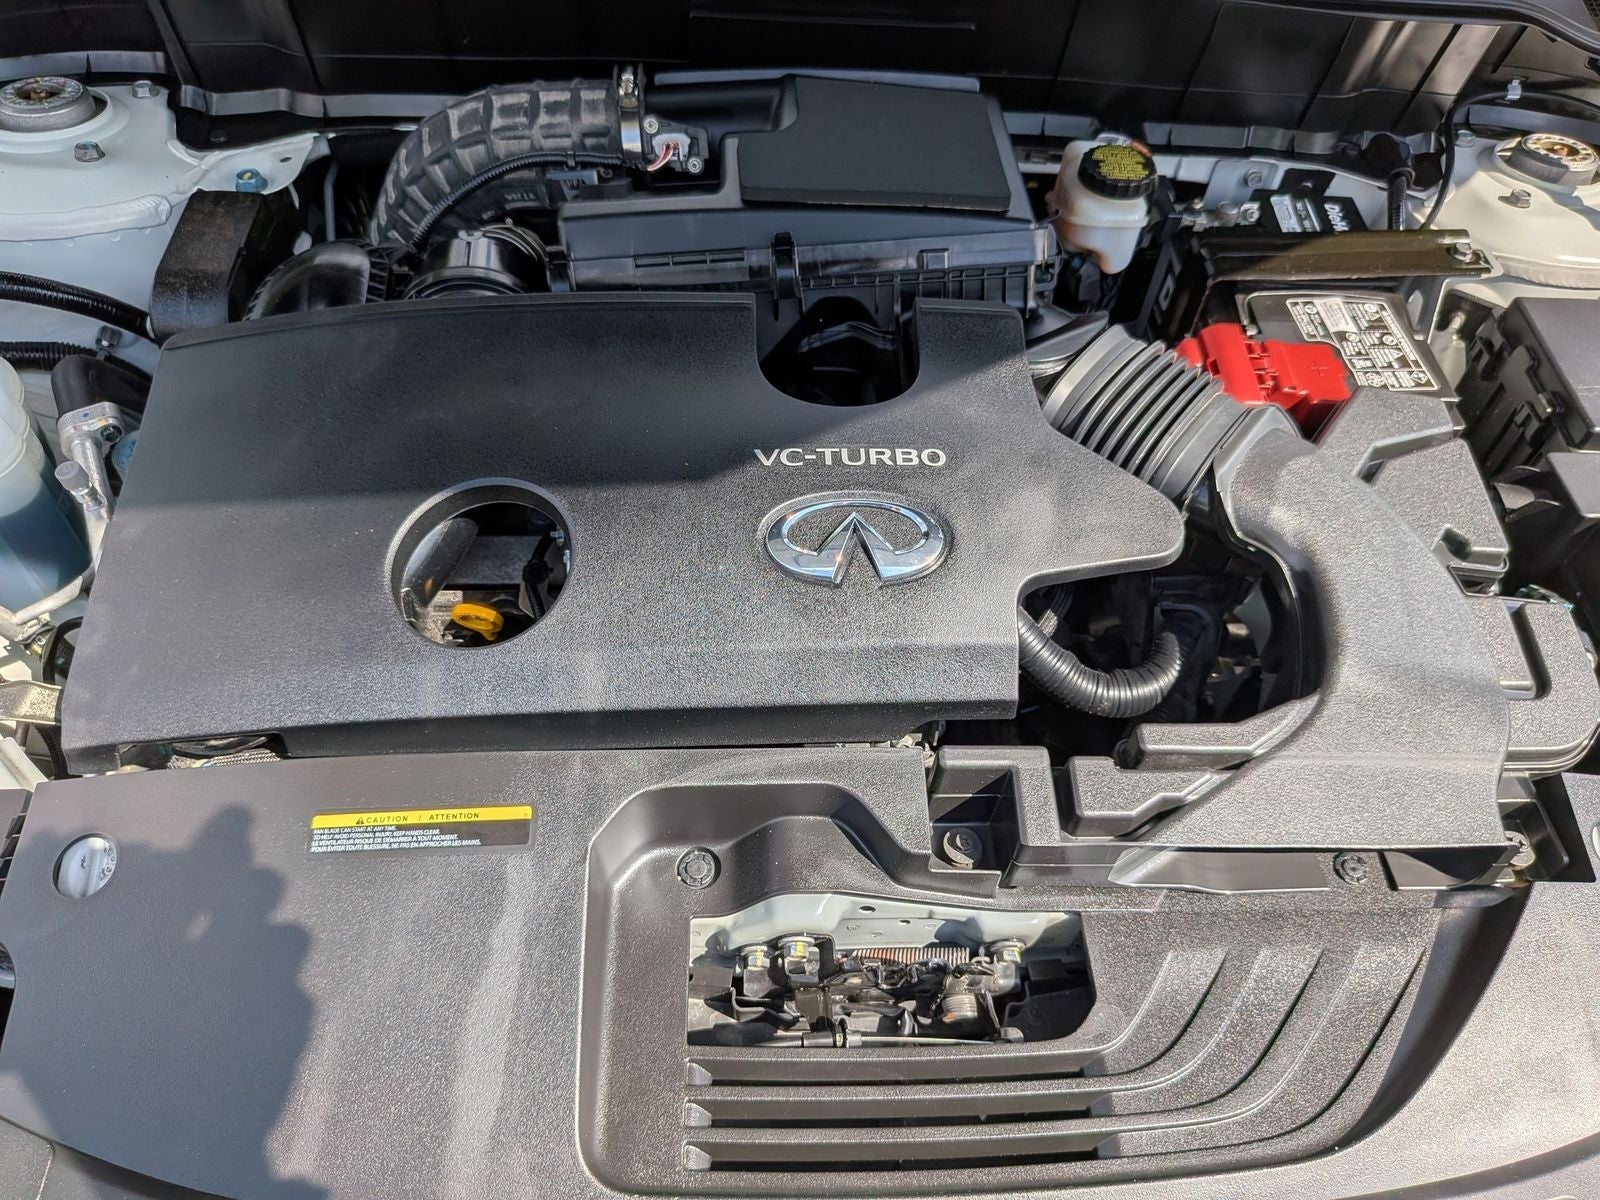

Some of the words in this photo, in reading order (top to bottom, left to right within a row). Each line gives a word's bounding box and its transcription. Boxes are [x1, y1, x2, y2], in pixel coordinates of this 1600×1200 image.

[753, 447, 947, 467] VC-TURBO
[366, 816, 409, 824] CAUTION
[429, 812, 480, 821] ATTENTION
[419, 840, 452, 848] APPROCHER
